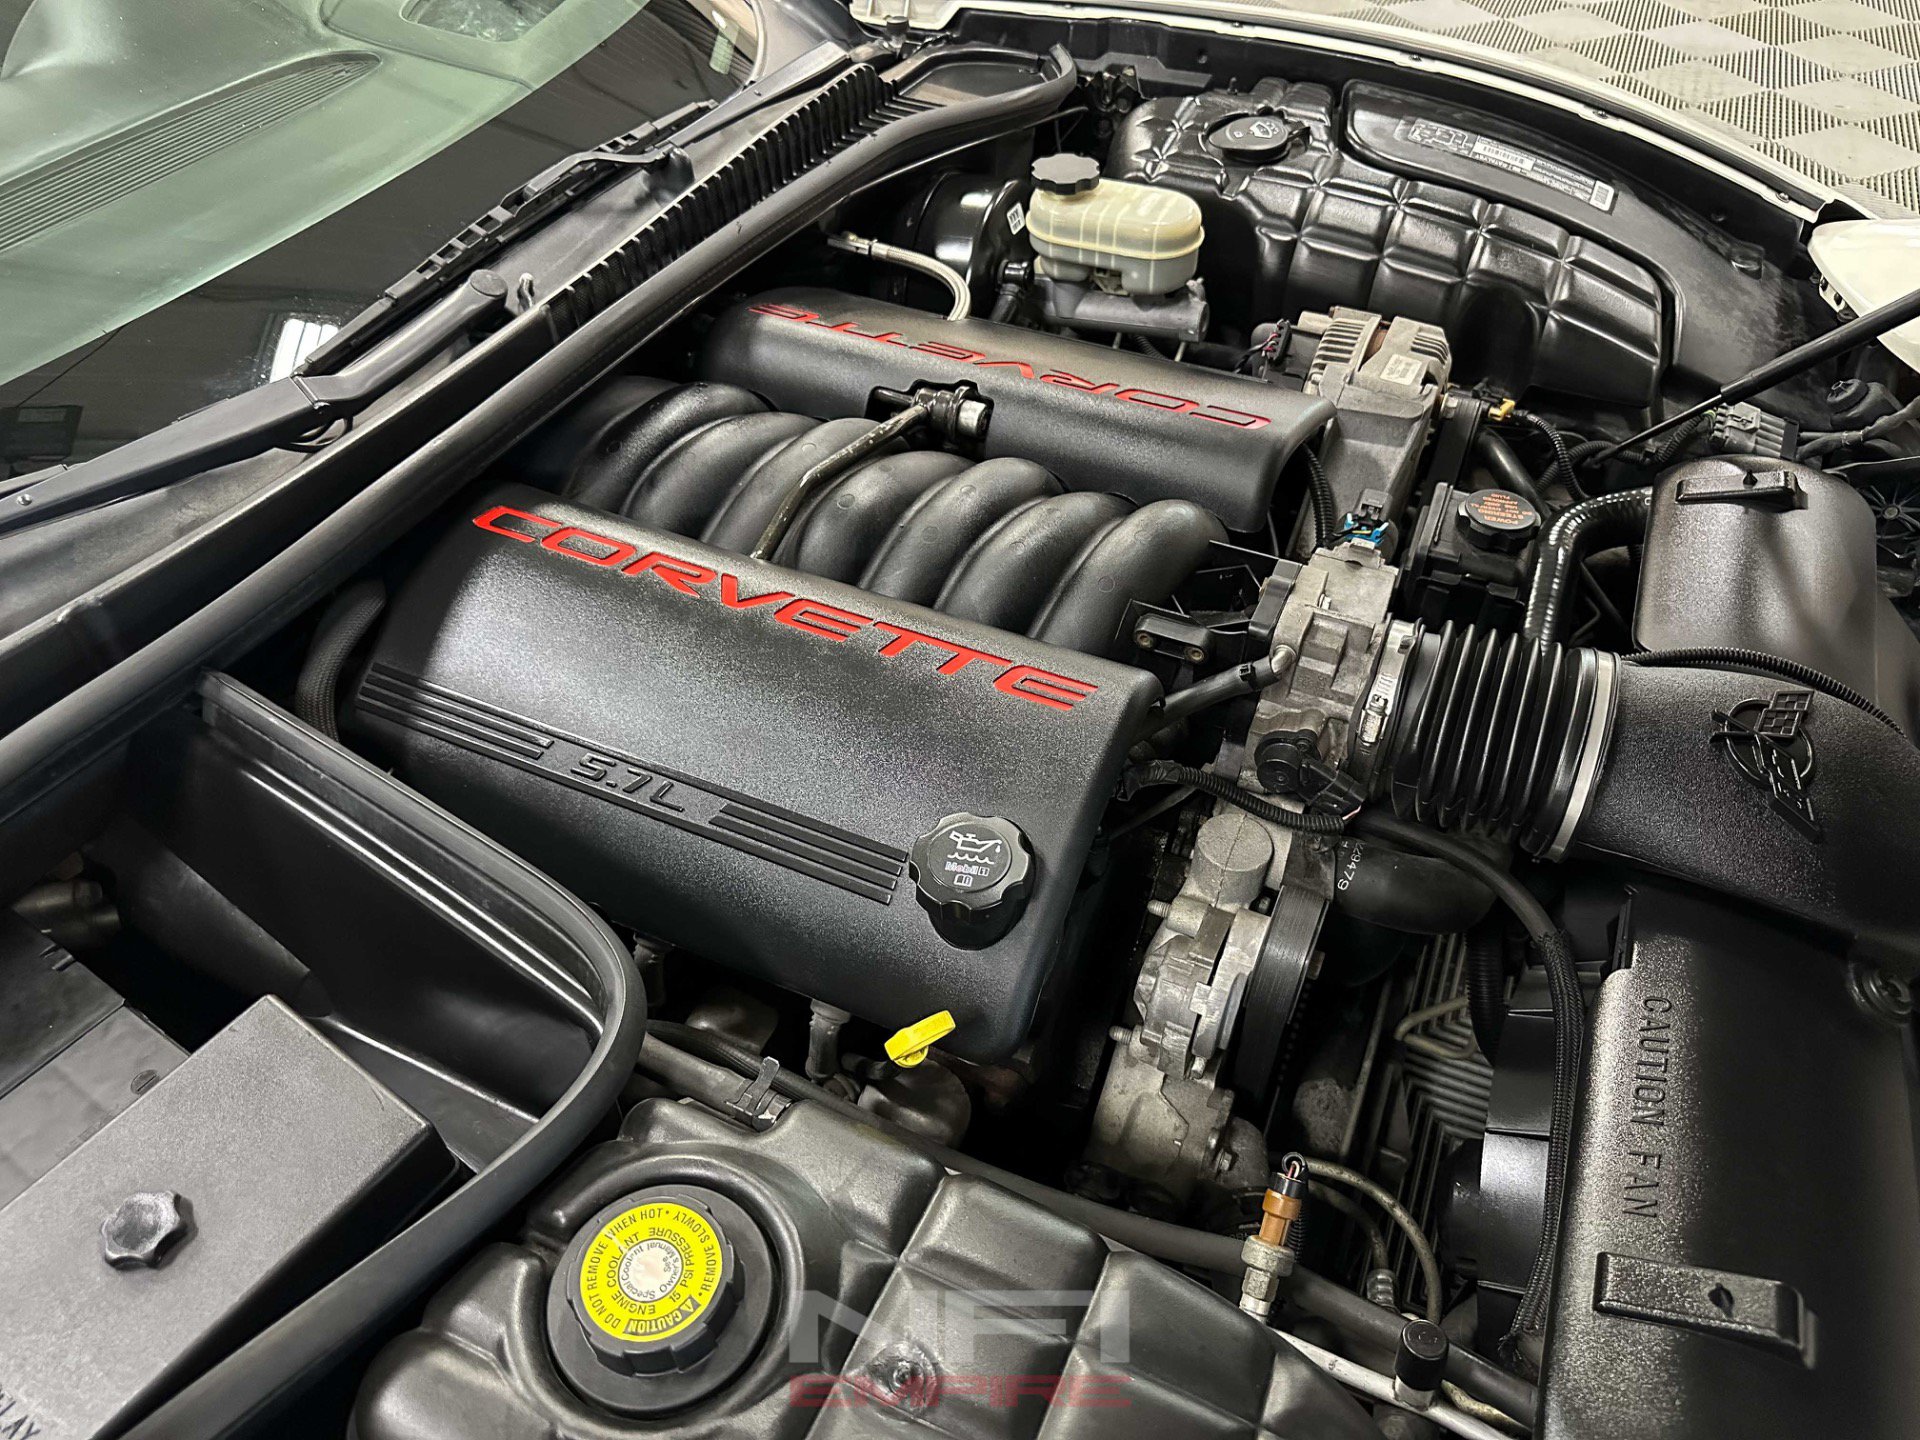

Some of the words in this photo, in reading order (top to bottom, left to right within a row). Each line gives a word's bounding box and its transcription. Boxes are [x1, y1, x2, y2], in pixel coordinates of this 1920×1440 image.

[747, 303, 1273, 431] CORVETTE
[1484, 515, 1519, 525] POWER
[472, 503, 1100, 711] CORVETTE
[570, 752, 685, 812] 5.7L
[1630, 997, 1672, 1126] CAUTION
[1622, 1151, 1662, 1219] FAN
[604, 1213, 637, 1240] WHEN
[640, 1207, 664, 1220] HOT
[672, 1210, 710, 1244] SLOWLY
[646, 1241, 677, 1258] Manual
[648, 1227, 695, 1266] PRESSURE
[587, 1242, 609, 1290] REMOVE
[679, 1268, 695, 1288] PSI
[700, 1244, 717, 1292] REMOVE
[611, 1290, 656, 1315] ENGINE
[623, 1280, 656, 1299] Special
[668, 1291, 682, 1303] 15
[588, 1294, 607, 1316] NOT
[604, 1312, 621, 1329] DO
[628, 1311, 682, 1333] CAUTION
